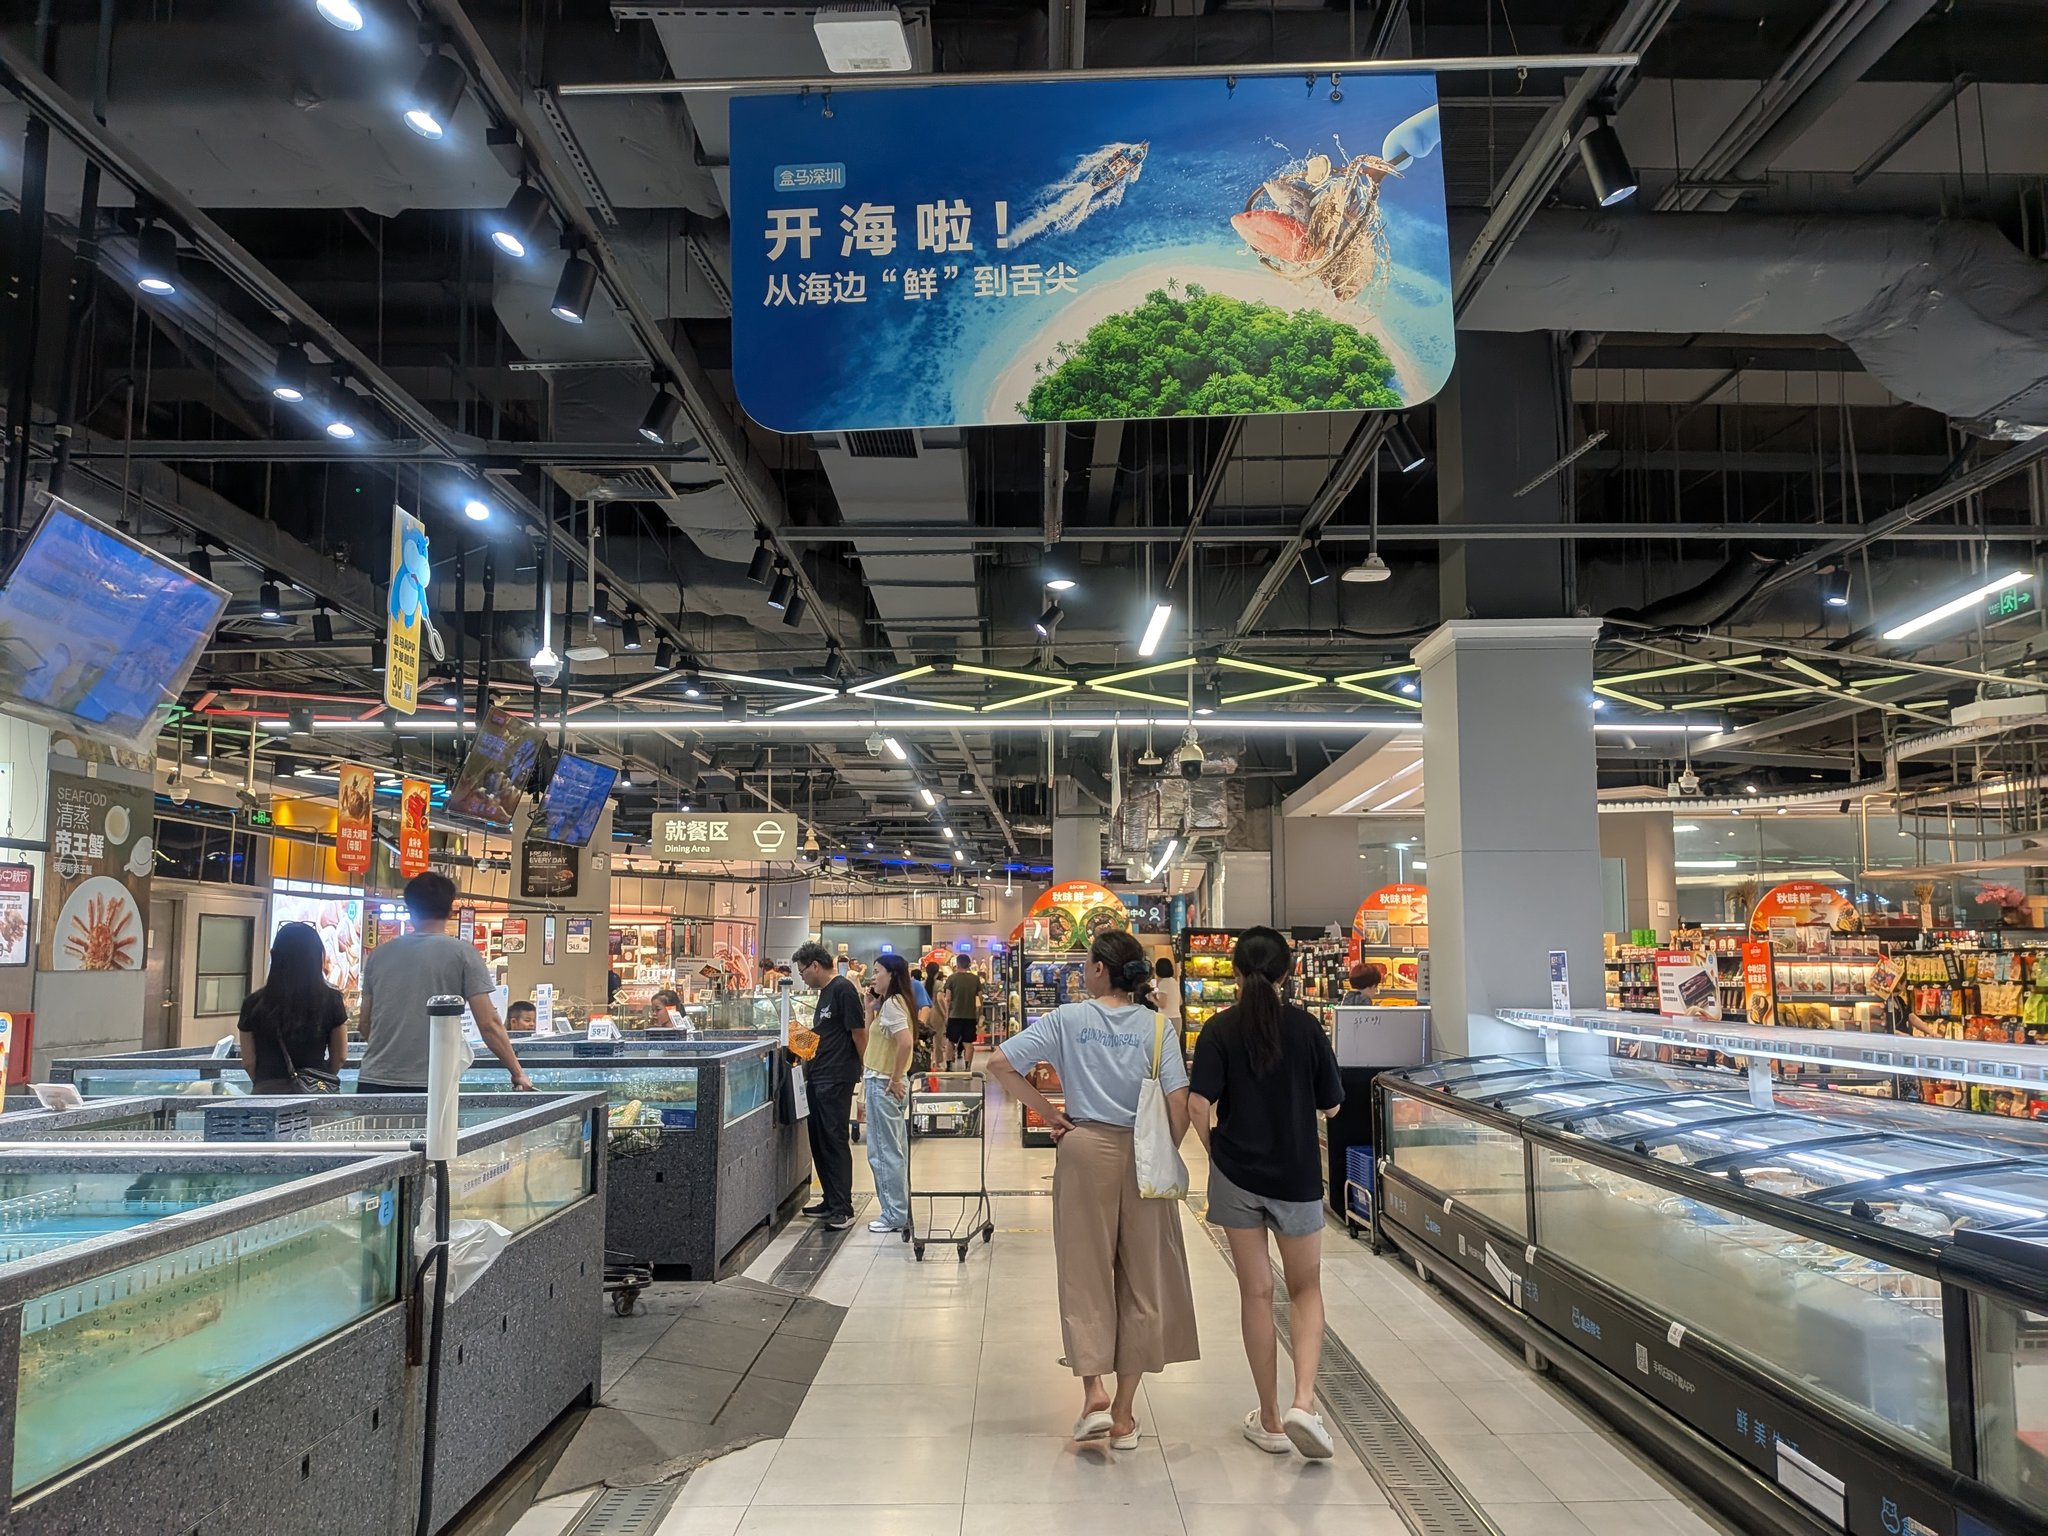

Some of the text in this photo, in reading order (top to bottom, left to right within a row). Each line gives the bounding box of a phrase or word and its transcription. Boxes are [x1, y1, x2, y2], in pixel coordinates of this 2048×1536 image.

[778, 168, 841, 187] 盒马深圳
[391, 665, 403, 690] 30
[57, 787, 107, 806] SEAFOOD
[56, 801, 91, 831] 清蒸
[665, 820, 729, 841] 就餐区
[55, 829, 105, 859] 帝王蟹
[665, 844, 710, 854] Dining Area
[0, 870, 28, 883] 中秋节
